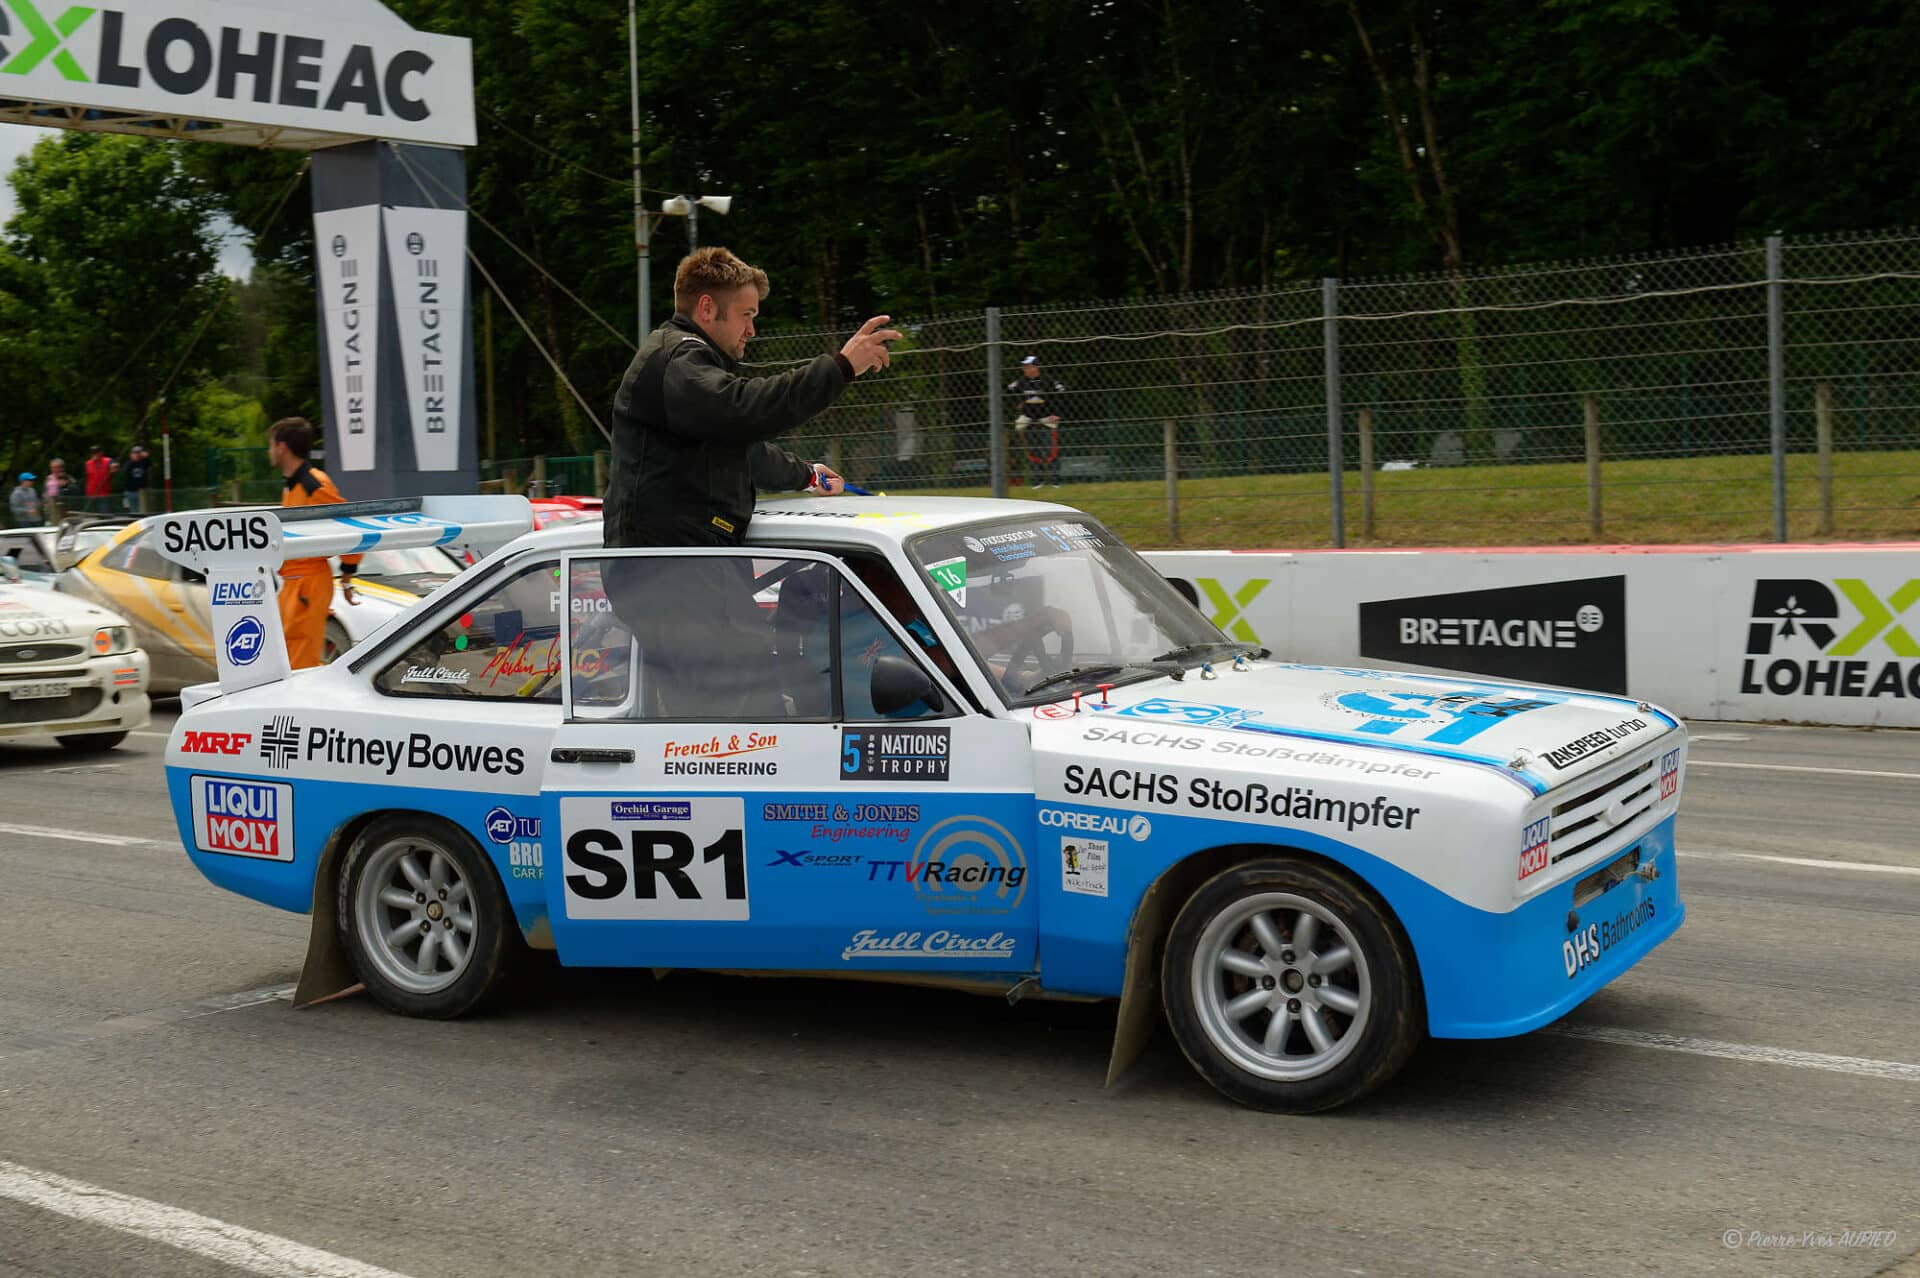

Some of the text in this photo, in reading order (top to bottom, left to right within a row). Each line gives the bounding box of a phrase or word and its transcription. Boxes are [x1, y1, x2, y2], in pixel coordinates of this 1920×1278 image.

[0, 0, 434, 122] X LOHEAC
[341, 259, 364, 434] BRETAGNE
[418, 259, 444, 433] BRETAGNE
[164, 516, 269, 553] SACHS
[937, 568, 962, 587] 16
[212, 580, 266, 606] LENCO
[1745, 578, 1920, 656] RX
[230, 632, 260, 650] AET
[1399, 616, 1577, 650] BRETAGNE
[433, 668, 470, 680] Circle
[181, 731, 252, 755] MRF
[664, 732, 778, 758] French & Son
[1082, 726, 1205, 752] SACHS
[1537, 718, 1647, 770] ZAKSPEED turbo
[843, 734, 947, 773] 5 NATIONS
[880, 760, 947, 773] TROPHY
[1662, 752, 1679, 776] LIQUI
[664, 761, 777, 775] ENGINEERING
[1063, 764, 1421, 832] SACHS Stoßdämpfer
[1662, 772, 1677, 798] MOLY
[208, 783, 275, 818] LIQUI
[615, 804, 689, 815] Orchid Garage
[764, 803, 920, 823] SMITH & JONES
[488, 819, 513, 833] AET
[811, 823, 910, 842] Engineering
[1038, 808, 1127, 835] CORBEAU
[1523, 818, 1549, 849] LIQUI
[209, 817, 276, 855] MOLY
[565, 828, 746, 900] SR1
[1520, 847, 1548, 878] MOLY
[1602, 896, 1656, 951] Bathrooms
[848, 930, 1016, 954] Full Circle
[1562, 923, 1601, 978] DHS
